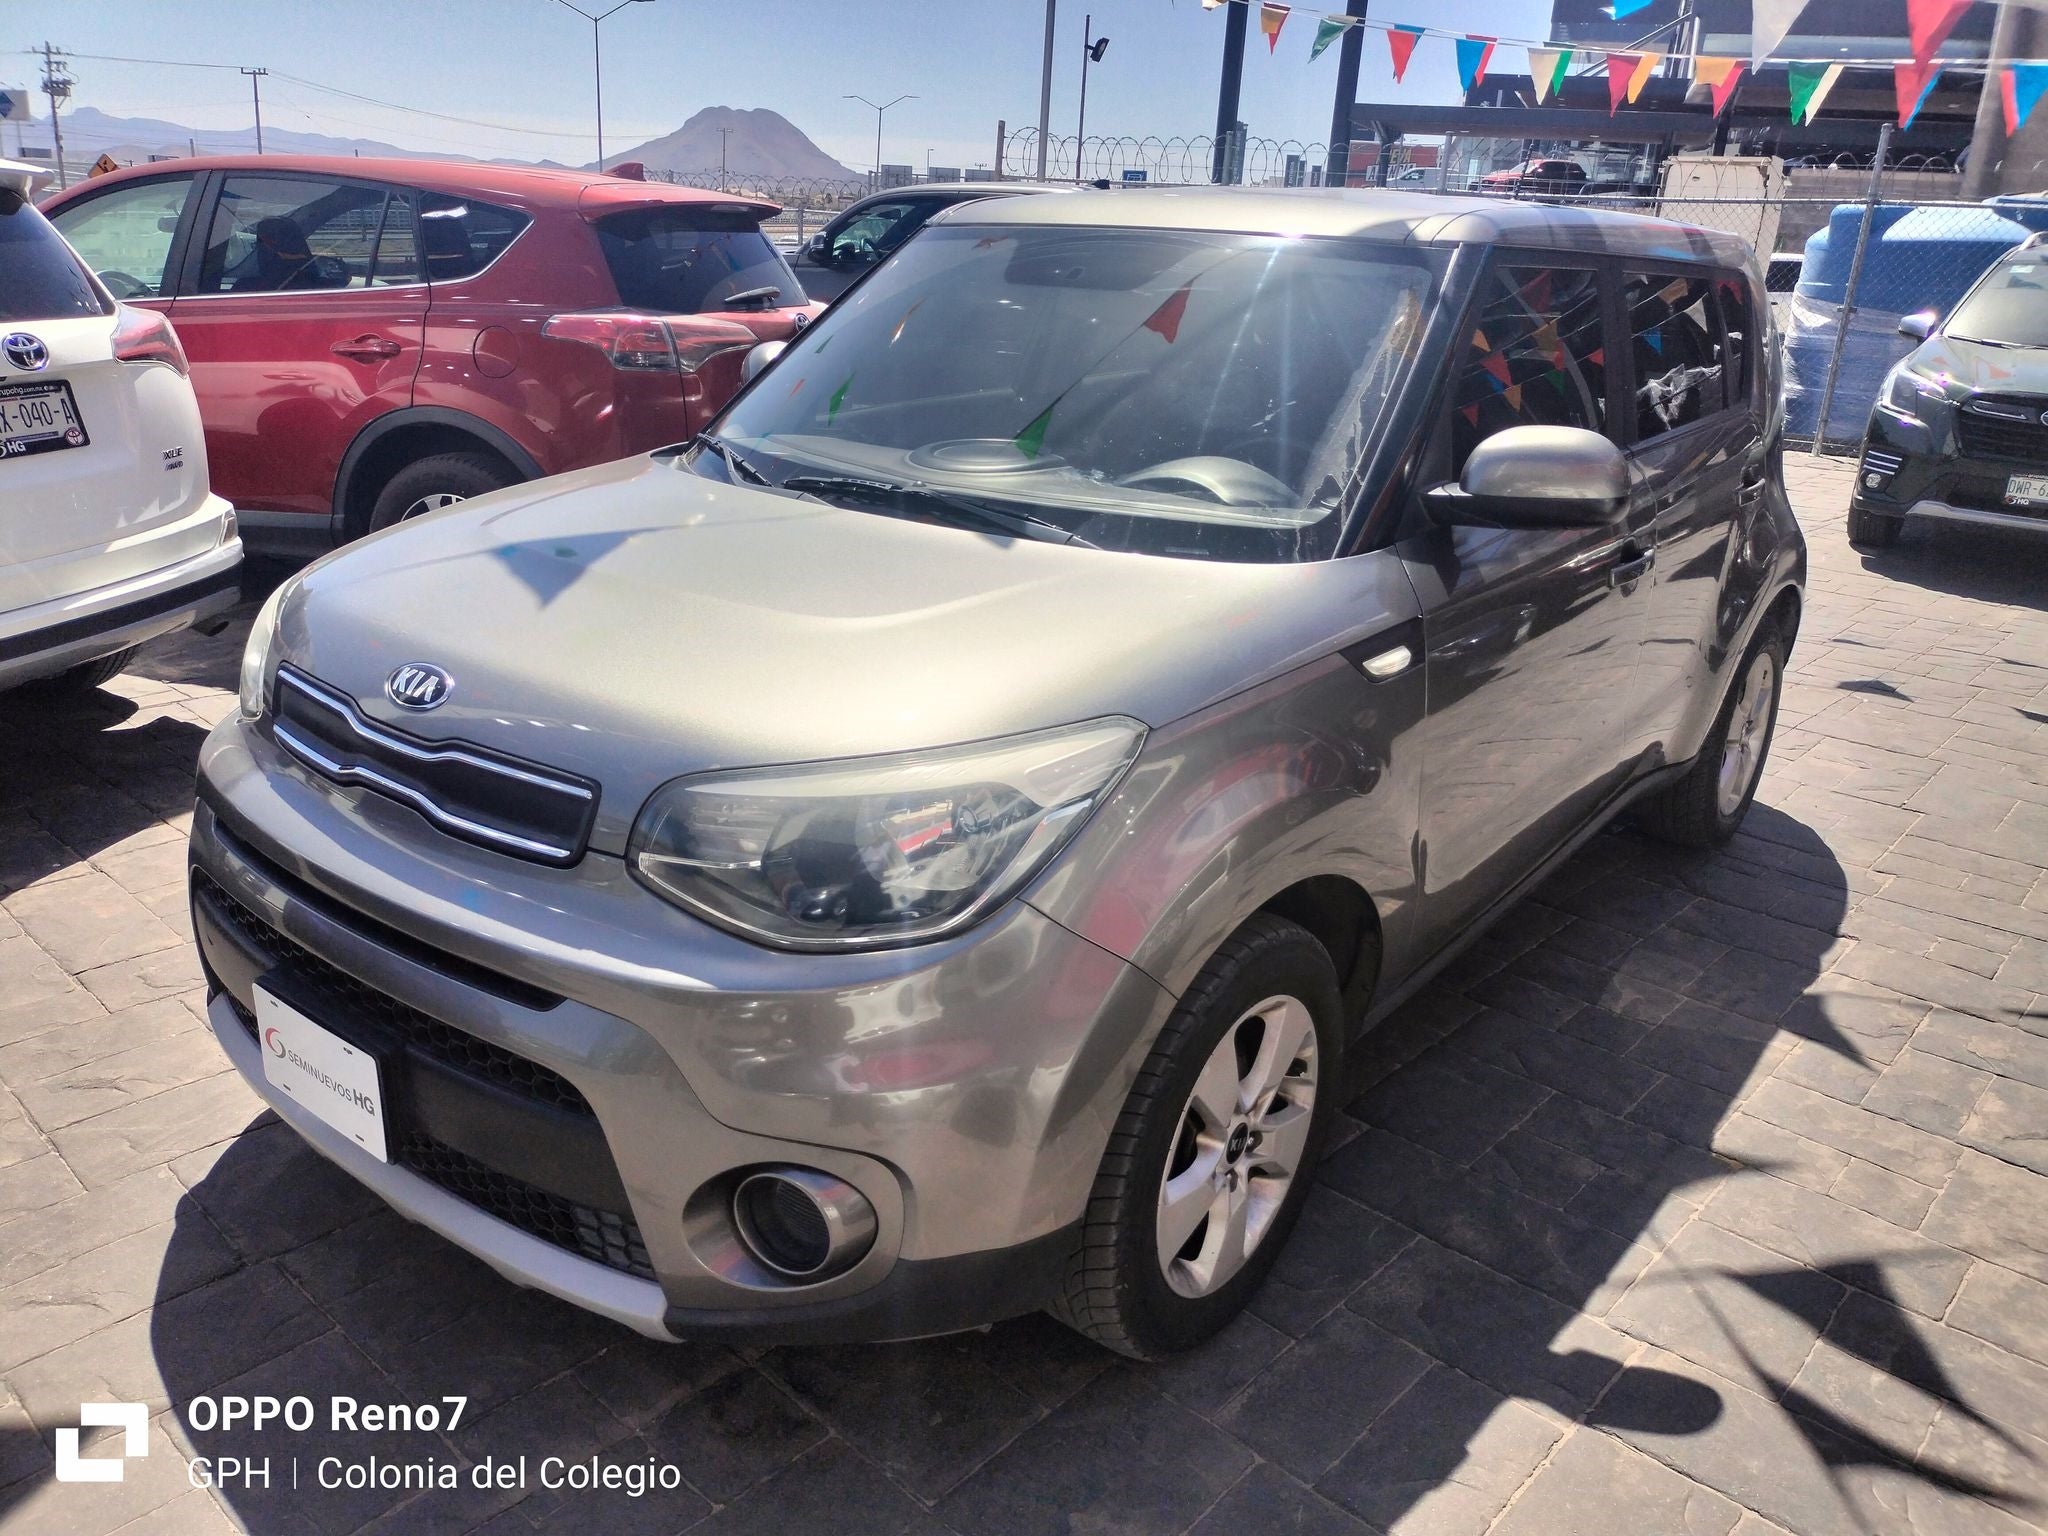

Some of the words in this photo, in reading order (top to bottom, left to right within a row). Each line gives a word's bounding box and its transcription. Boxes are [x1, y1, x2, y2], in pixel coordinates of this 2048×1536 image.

[0, 398, 75, 434] X-040-A
[2008, 479, 2048, 497] DWR-6
[392, 666, 439, 702] KIA
